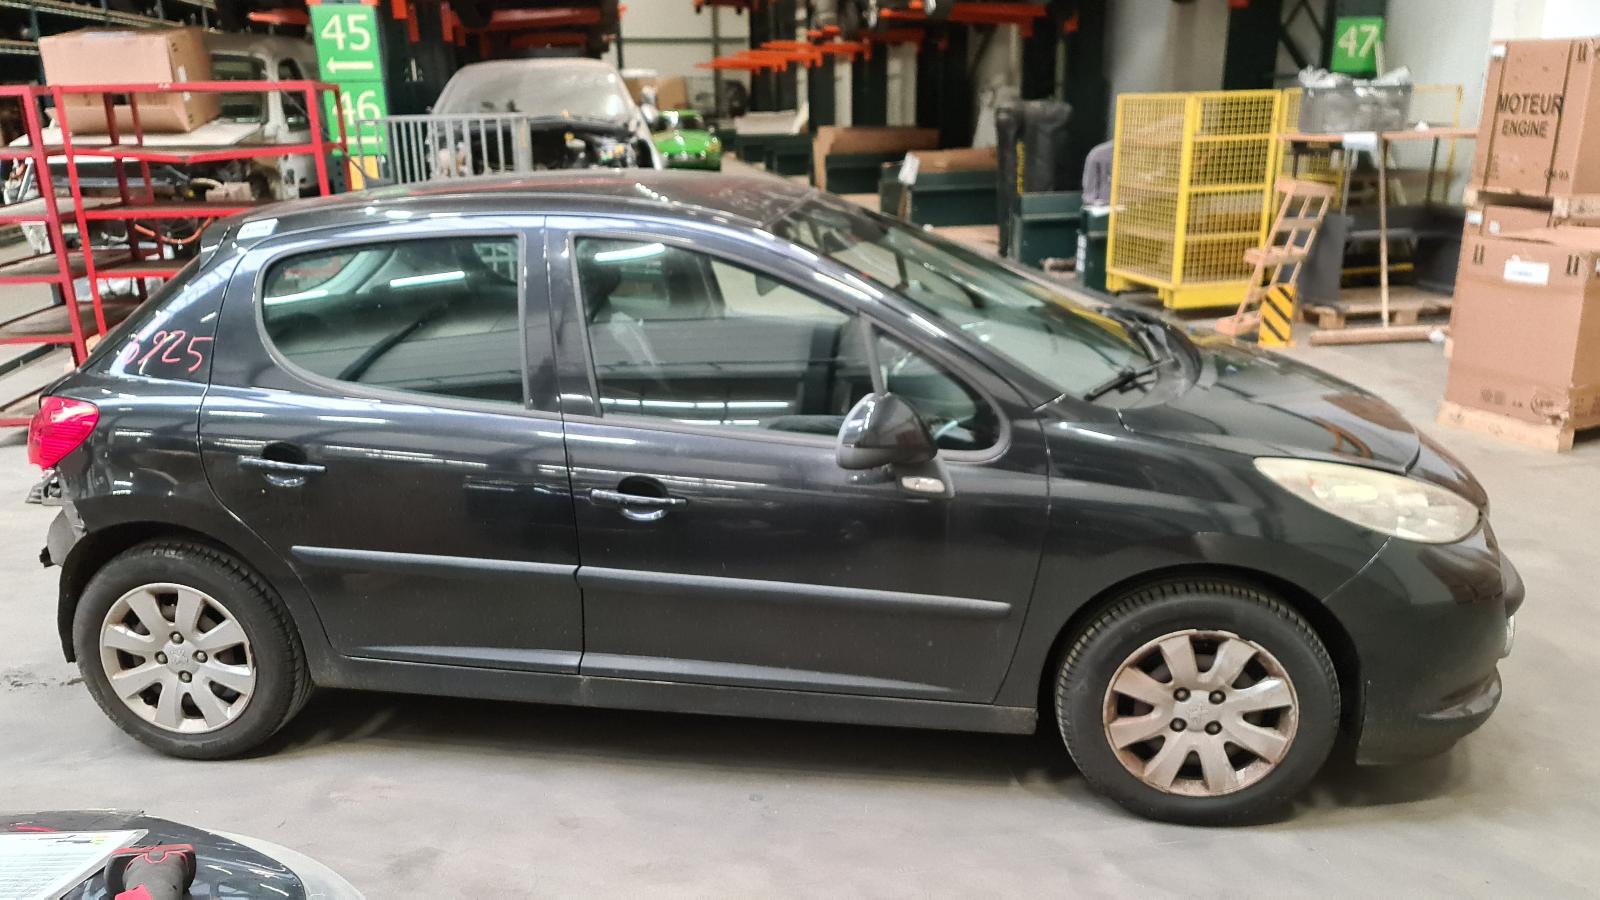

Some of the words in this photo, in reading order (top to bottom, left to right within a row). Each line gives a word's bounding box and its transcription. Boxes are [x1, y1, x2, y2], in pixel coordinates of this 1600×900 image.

[321, 13, 371, 51] 45
[1337, 24, 1377, 58] 47
[332, 90, 381, 126] 46
[1497, 93, 1564, 115] MOTEUR
[1501, 119, 1548, 138] ENGINE
